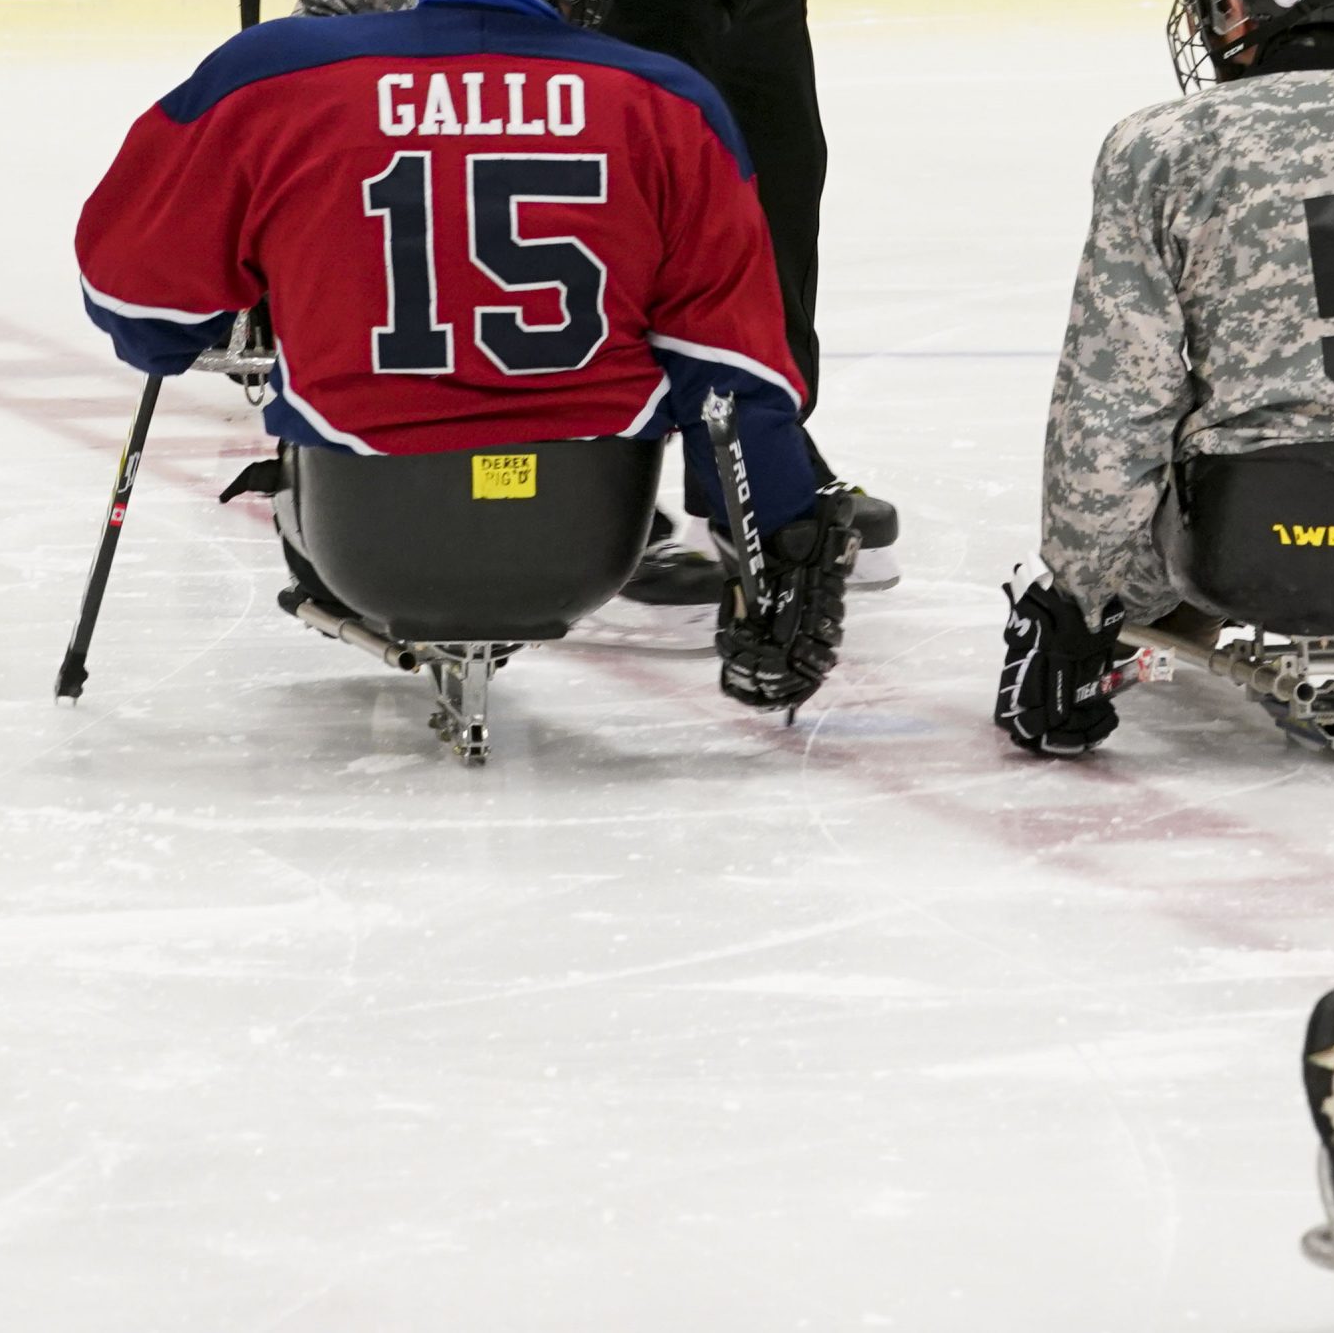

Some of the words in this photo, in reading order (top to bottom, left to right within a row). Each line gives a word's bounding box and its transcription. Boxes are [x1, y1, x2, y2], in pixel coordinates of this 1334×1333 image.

[377, 73, 585, 136] GALLO
[361, 150, 609, 376] 15
[729, 438, 752, 505] PRO
